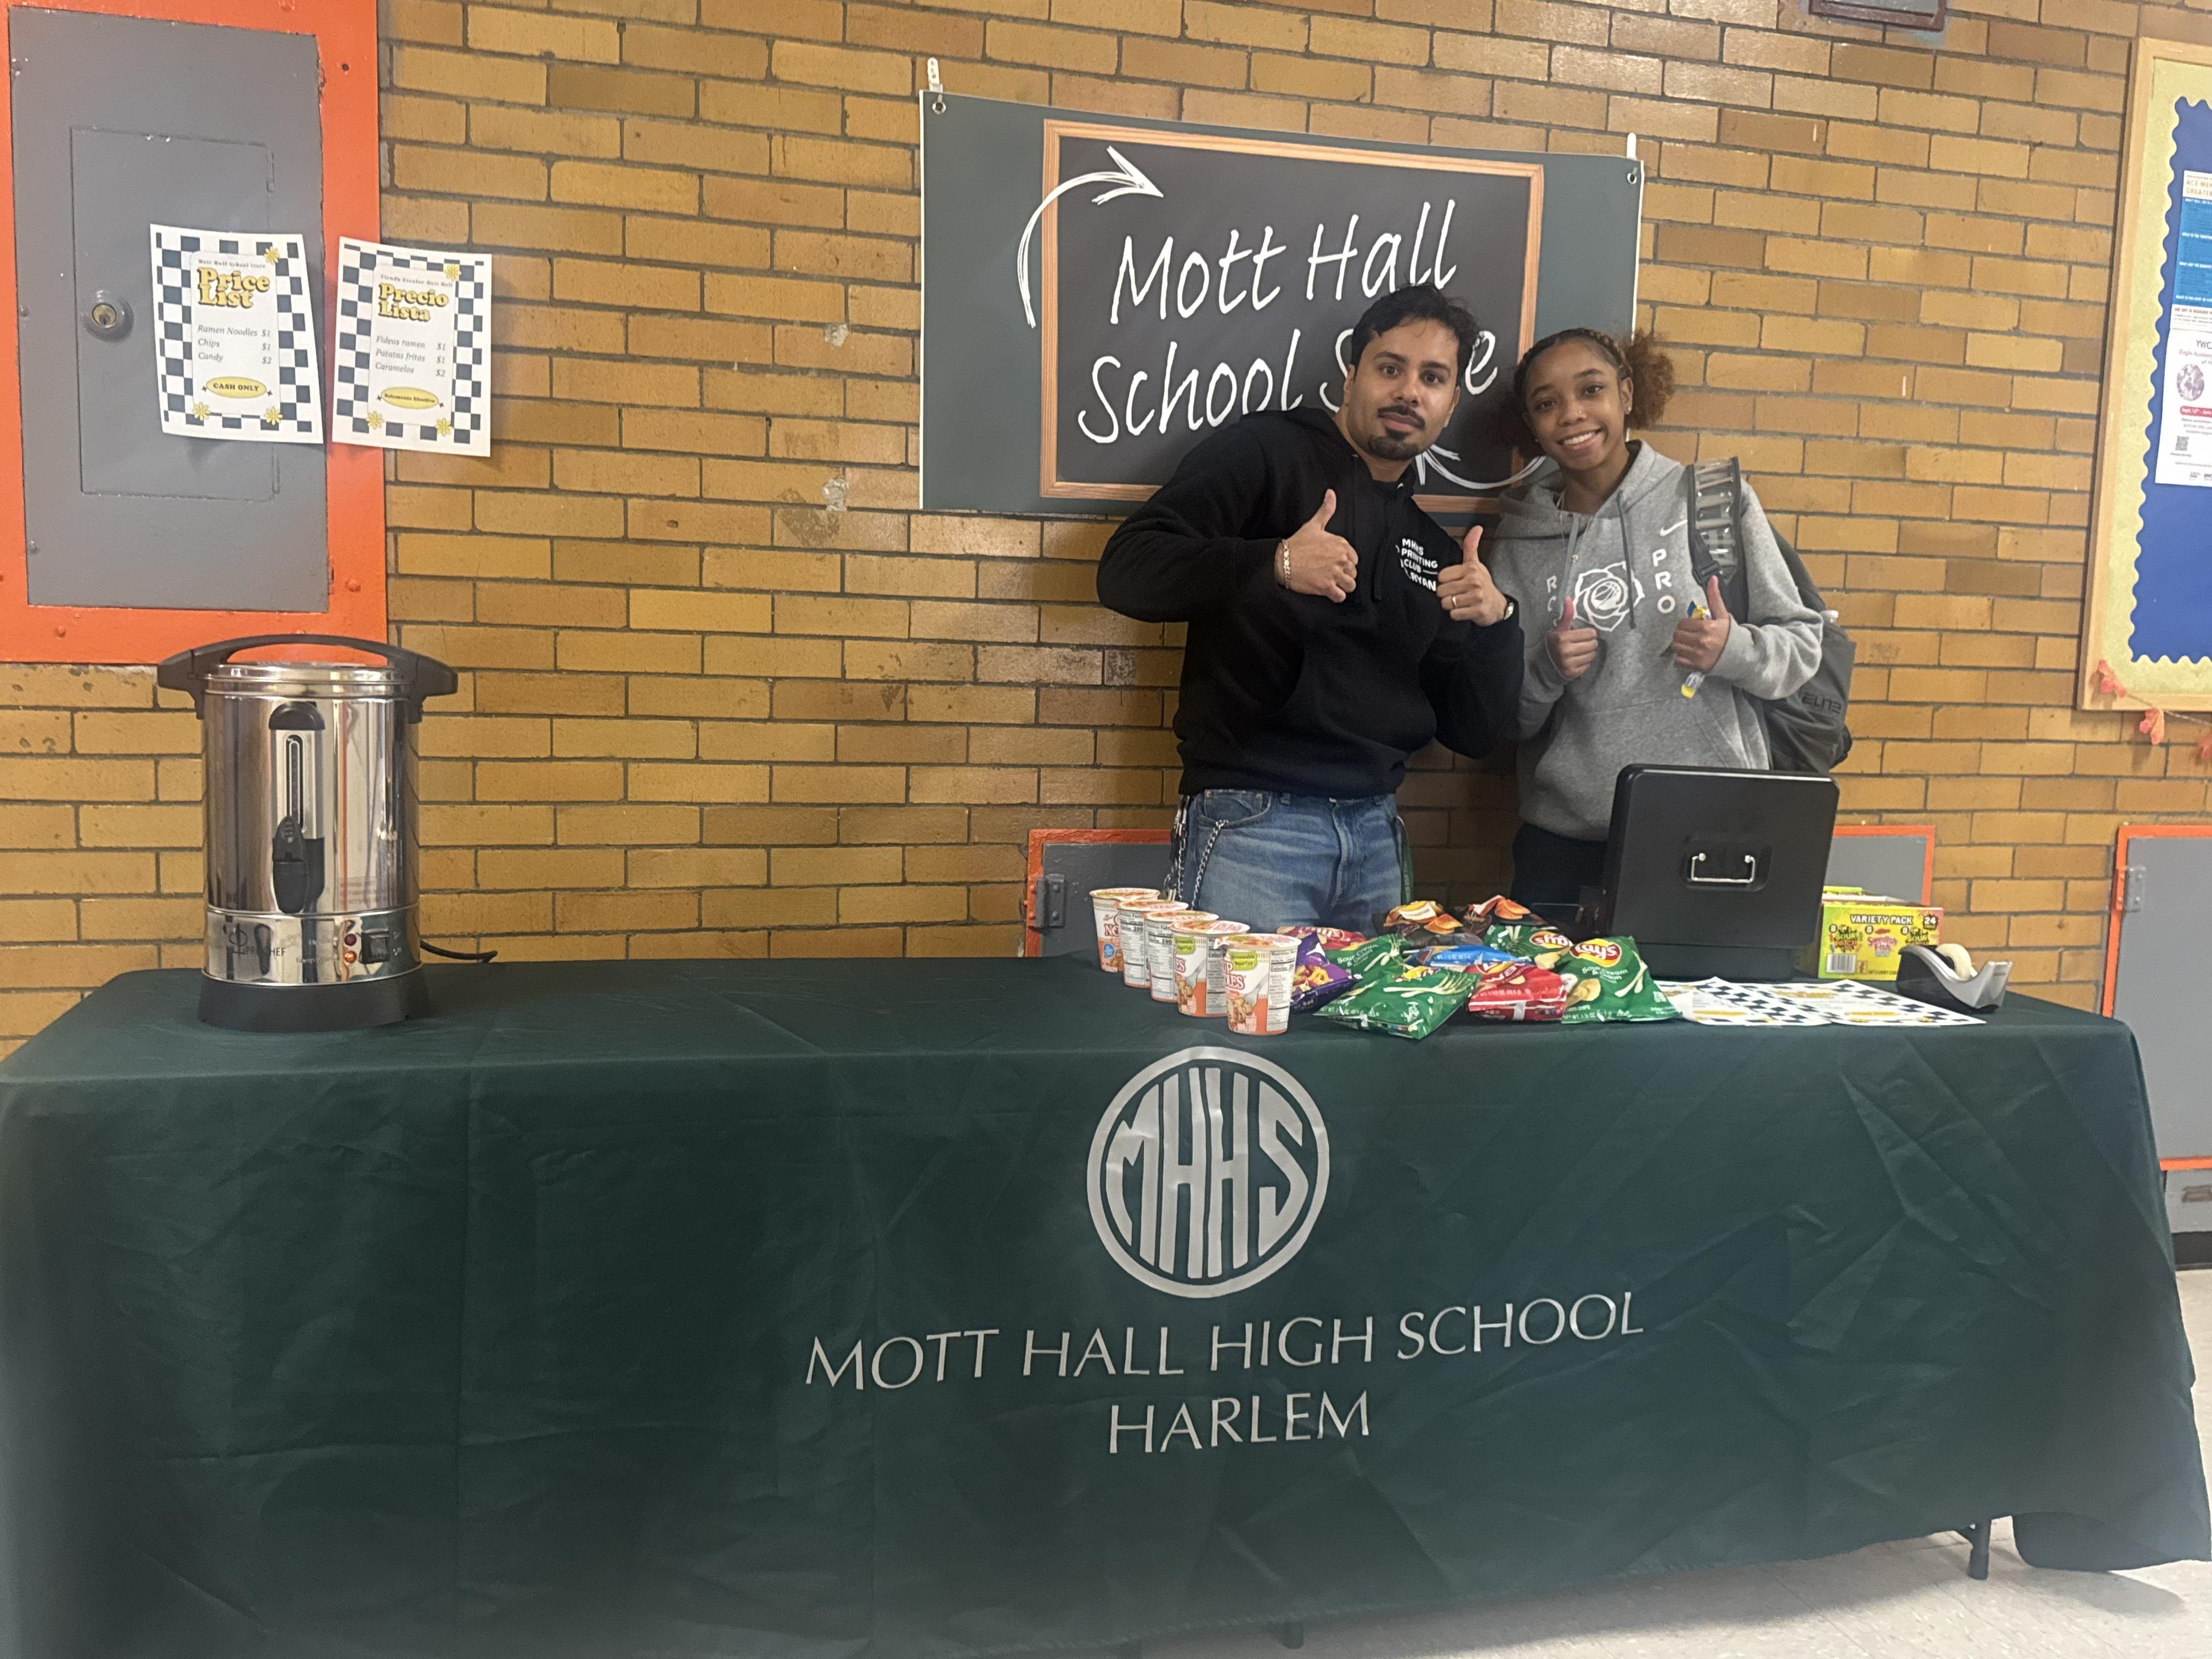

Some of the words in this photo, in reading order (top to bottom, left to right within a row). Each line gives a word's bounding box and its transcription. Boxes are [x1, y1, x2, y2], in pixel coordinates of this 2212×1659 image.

[1110, 225, 1286, 324] Mott
[1306, 199, 1457, 301] Hall
[197, 267, 270, 292] Price
[198, 284, 253, 308] List
[379, 283, 449, 307] Precio
[378, 299, 431, 322] Lista
[198, 325, 224, 334] Ramen
[227, 327, 258, 336] Noodles
[262, 329, 270, 337] $1
[198, 338, 219, 348] Chips
[262, 343, 270, 351] $1
[376, 335, 400, 346] Fideos
[198, 352, 223, 362] Candy
[262, 356, 272, 365] $2
[376, 348, 404, 359] Patatas
[405, 352, 425, 362] fritas
[375, 362, 415, 374] Caramelos
[436, 369, 445, 377] $2
[1078, 329, 1303, 443] School
[1402, 538, 1424, 556] MHHS
[1401, 548, 1438, 569] PRINTING
[1404, 558, 1421, 574] CLUB
[1850, 914, 1889, 924] VARIETY
[1890, 915, 1914, 925] PACK
[1923, 916, 1937, 925] 24
[1866, 926, 1873, 934] 8
[1901, 926, 1909, 935] 8
[1867, 935, 1898, 947] Swedish
[1874, 944, 1891, 952] Fish
[1337, 954, 1356, 964] Sour
[1582, 966, 1600, 974] Sour
[1107, 1067, 1309, 1279] MHHS
[806, 1329, 999, 1390] MOTT
[1023, 1327, 1184, 1376] HALL
[1210, 1316, 1373, 1371] HIGH
[1397, 1291, 1644, 1359] SCHOOL
[1109, 1391, 1369, 1453] HARLEM
